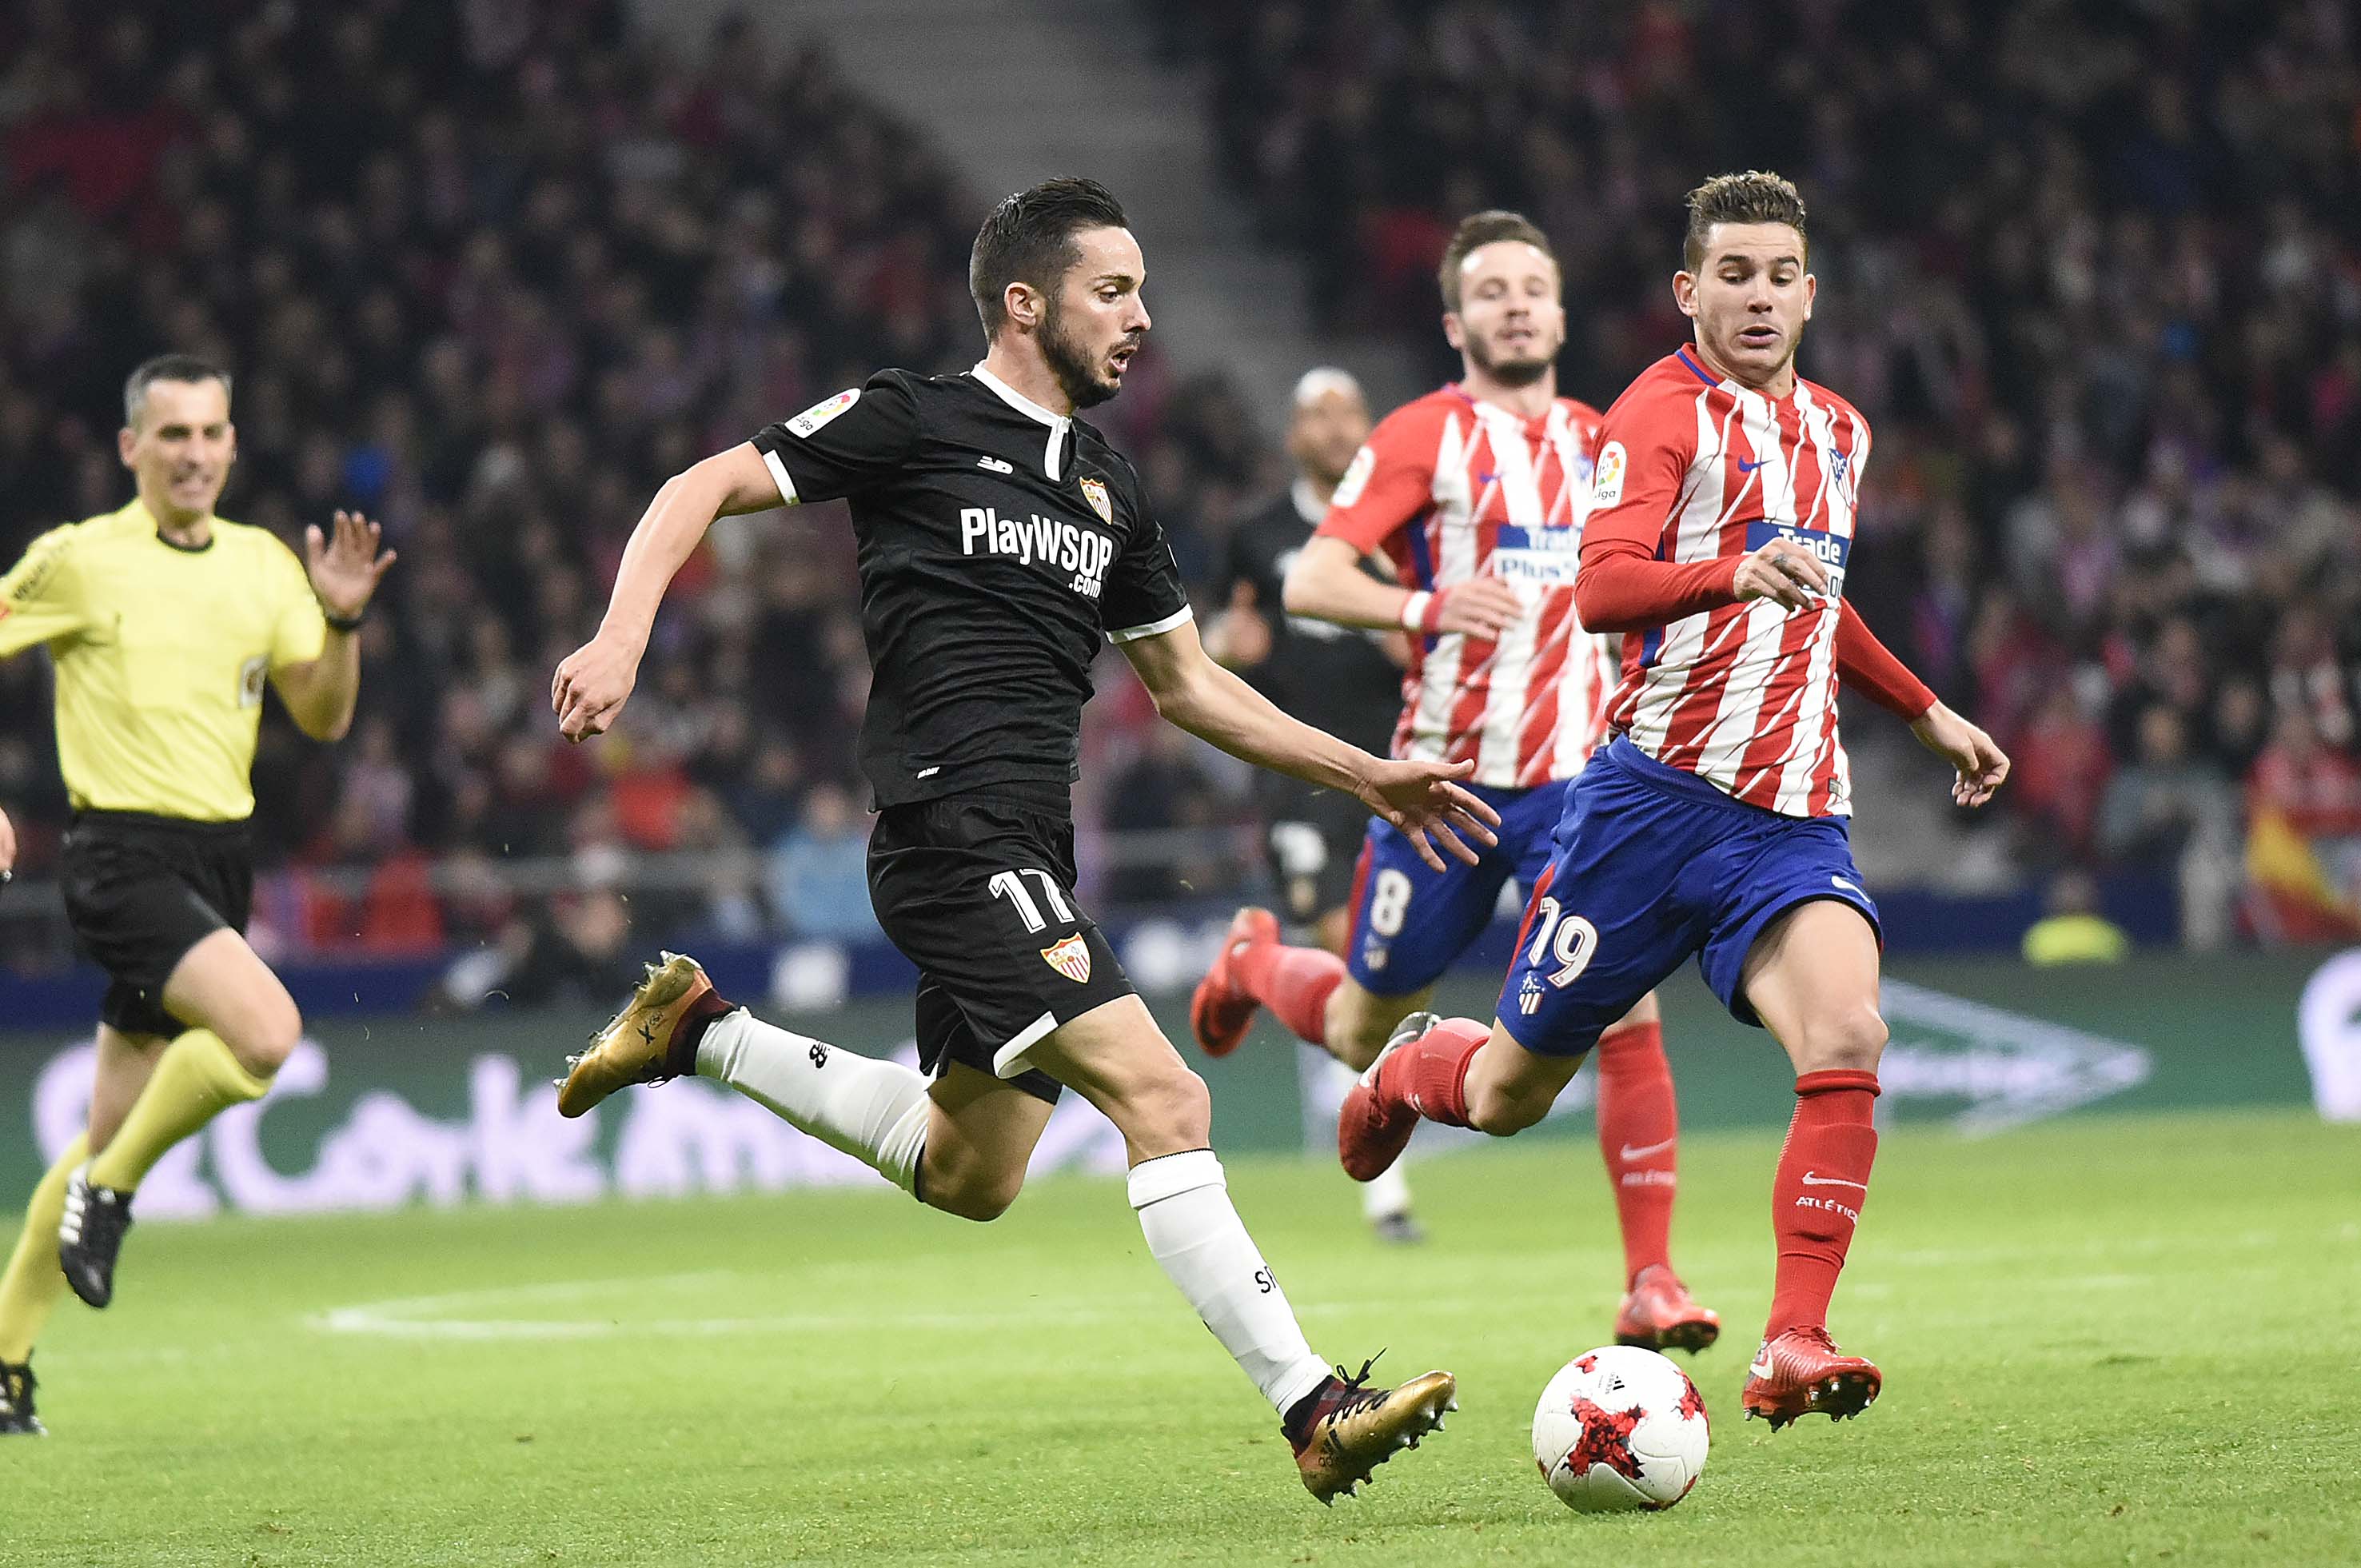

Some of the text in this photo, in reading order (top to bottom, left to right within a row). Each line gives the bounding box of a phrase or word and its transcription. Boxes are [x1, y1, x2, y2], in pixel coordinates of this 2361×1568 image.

[1594, 488, 1616, 500] iga
[960, 507, 1113, 581] PlayWSOP
[1523, 526, 1581, 550] Trad
[1068, 573, 1101, 598] .com
[988, 868, 1075, 934] 17
[1370, 868, 1413, 936] 8
[1528, 896, 1597, 988] 19
